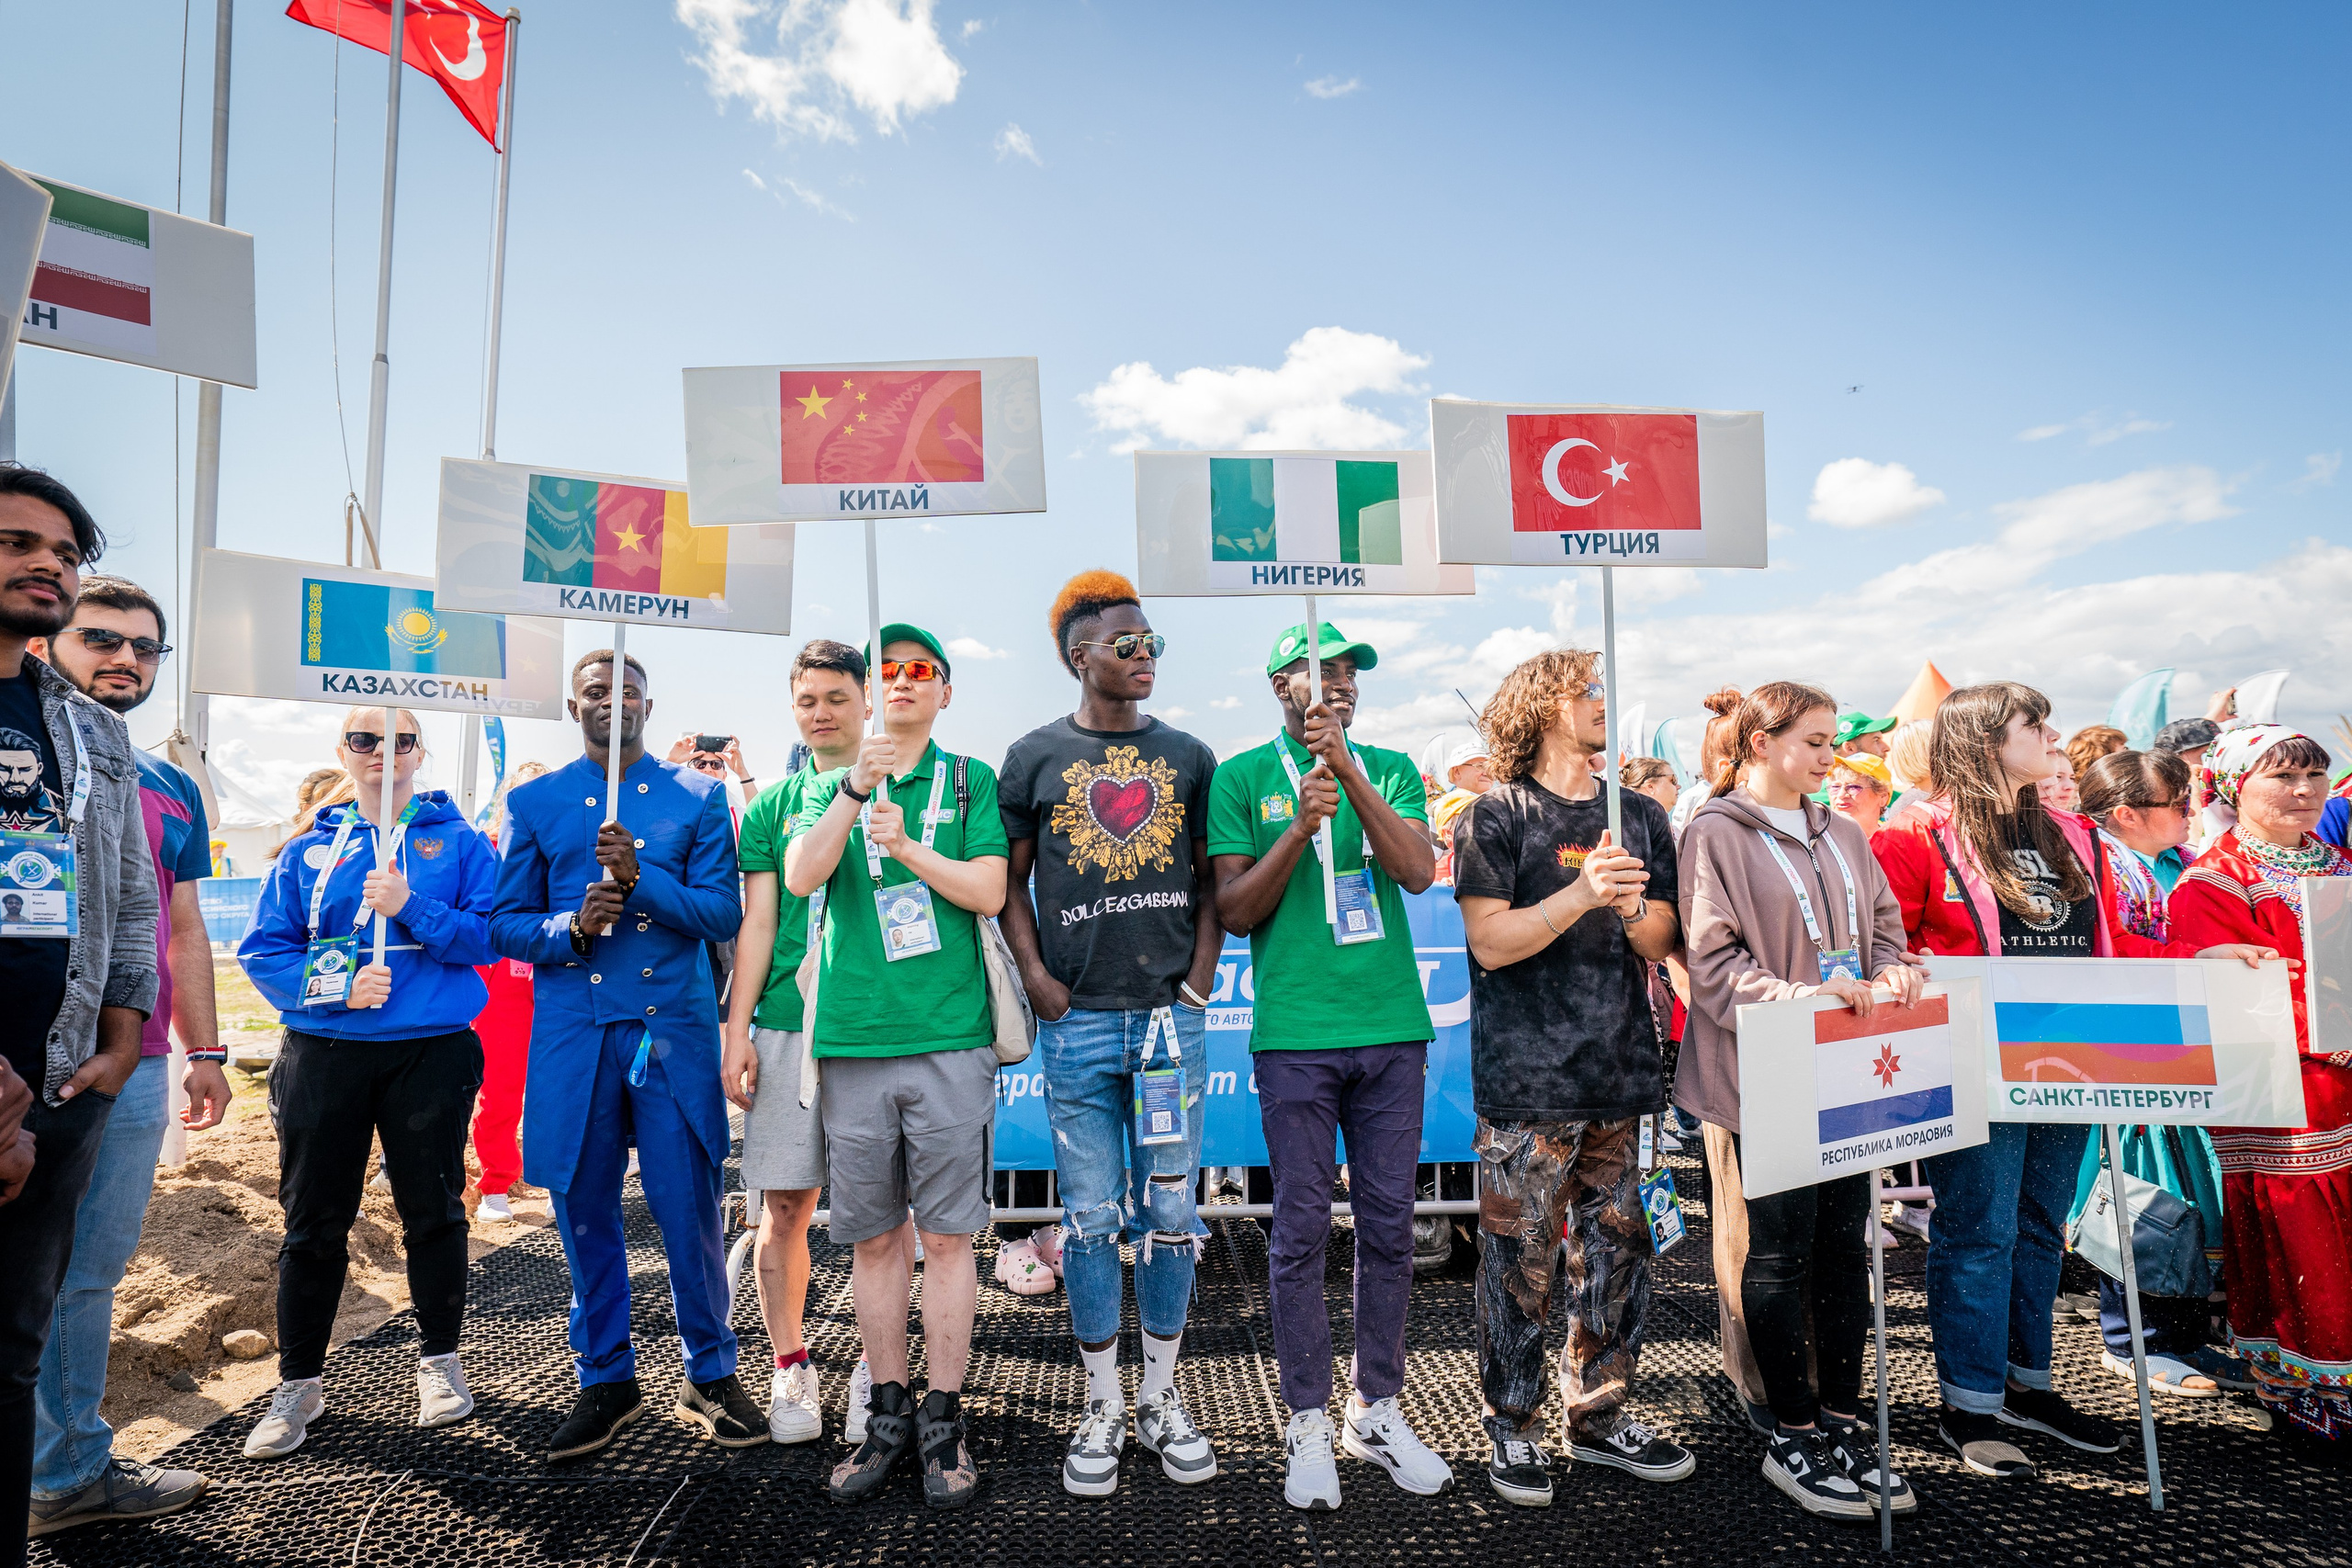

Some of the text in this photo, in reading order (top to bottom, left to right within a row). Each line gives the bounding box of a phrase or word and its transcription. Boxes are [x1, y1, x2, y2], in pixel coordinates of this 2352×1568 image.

[22, 302, 58, 331] Н
[840, 483, 929, 511] КИТАЙ
[1560, 532, 1660, 558] ТУРЦИЯ
[1251, 565, 1366, 587] НИГЕРИЯ
[559, 588, 690, 619] КАМЕРУН
[322, 672, 488, 701] КАЗАХСТАН
[2009, 1087, 2213, 1110] САНКТ-ПЕТЕРБУРГ
[1822, 1123, 1953, 1167] РЕСПУБЛИКА МОРДОВИЯ
